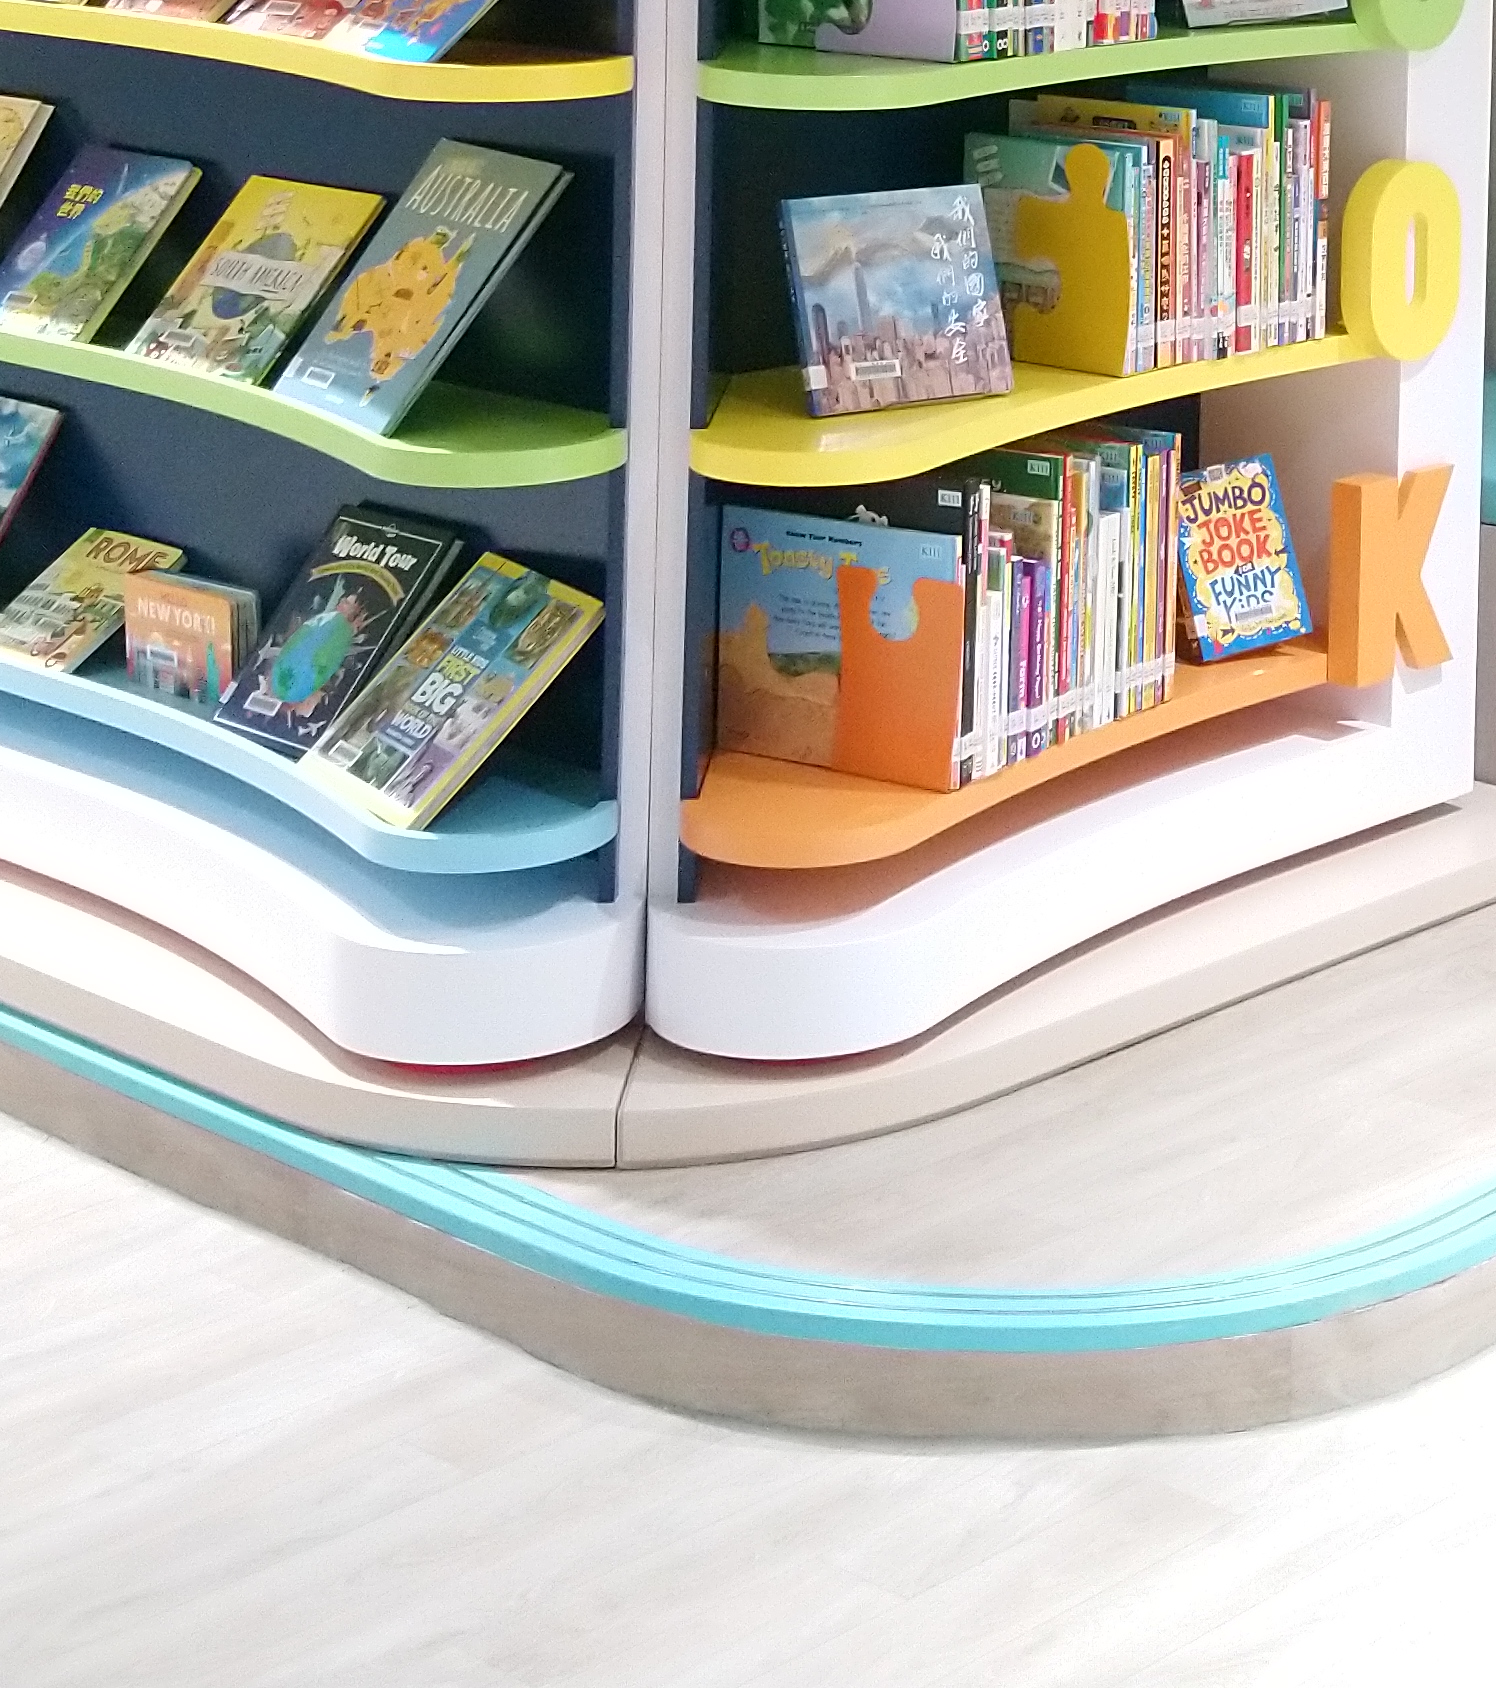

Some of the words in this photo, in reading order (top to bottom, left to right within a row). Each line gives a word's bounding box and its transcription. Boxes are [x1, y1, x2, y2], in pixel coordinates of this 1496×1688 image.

[405, 164, 529, 234] AUSTRALIA
[253, 261, 303, 292] AMERICA
[1180, 481, 1267, 524] JUMBO
[1197, 508, 1270, 548] JOKE
[85, 536, 171, 574] ROME
[331, 534, 385, 562] World
[379, 545, 418, 571] Tour
[1197, 533, 1274, 576] BOOK
[1208, 566, 1282, 607] FUNNY
[136, 597, 171, 623] NEW
[410, 672, 464, 716] BIG
[390, 709, 433, 739] WORLD
